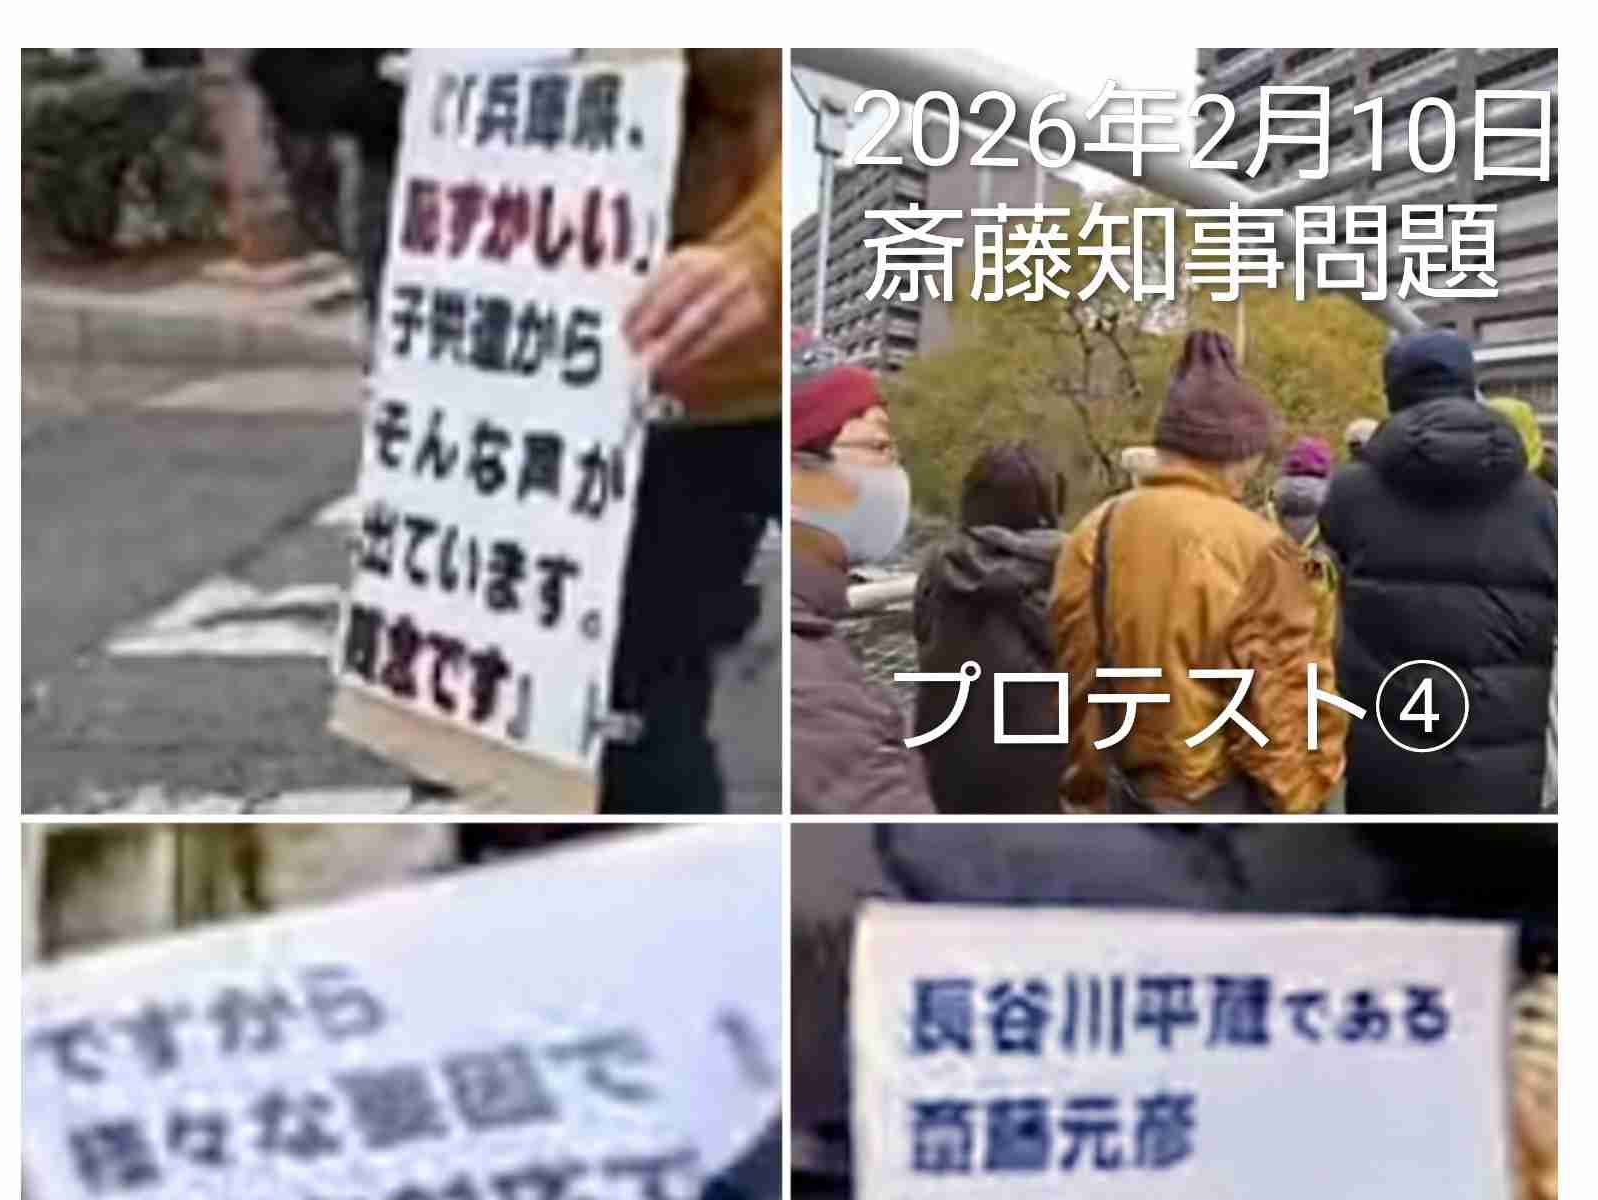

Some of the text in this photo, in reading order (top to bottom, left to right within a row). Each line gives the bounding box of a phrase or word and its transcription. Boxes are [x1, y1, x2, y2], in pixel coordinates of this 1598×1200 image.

[391, 288, 604, 387] 子供達から
[372, 401, 626, 518] そんな声が
[356, 500, 603, 642] 出ています。
[32, 963, 386, 1084] ですから
